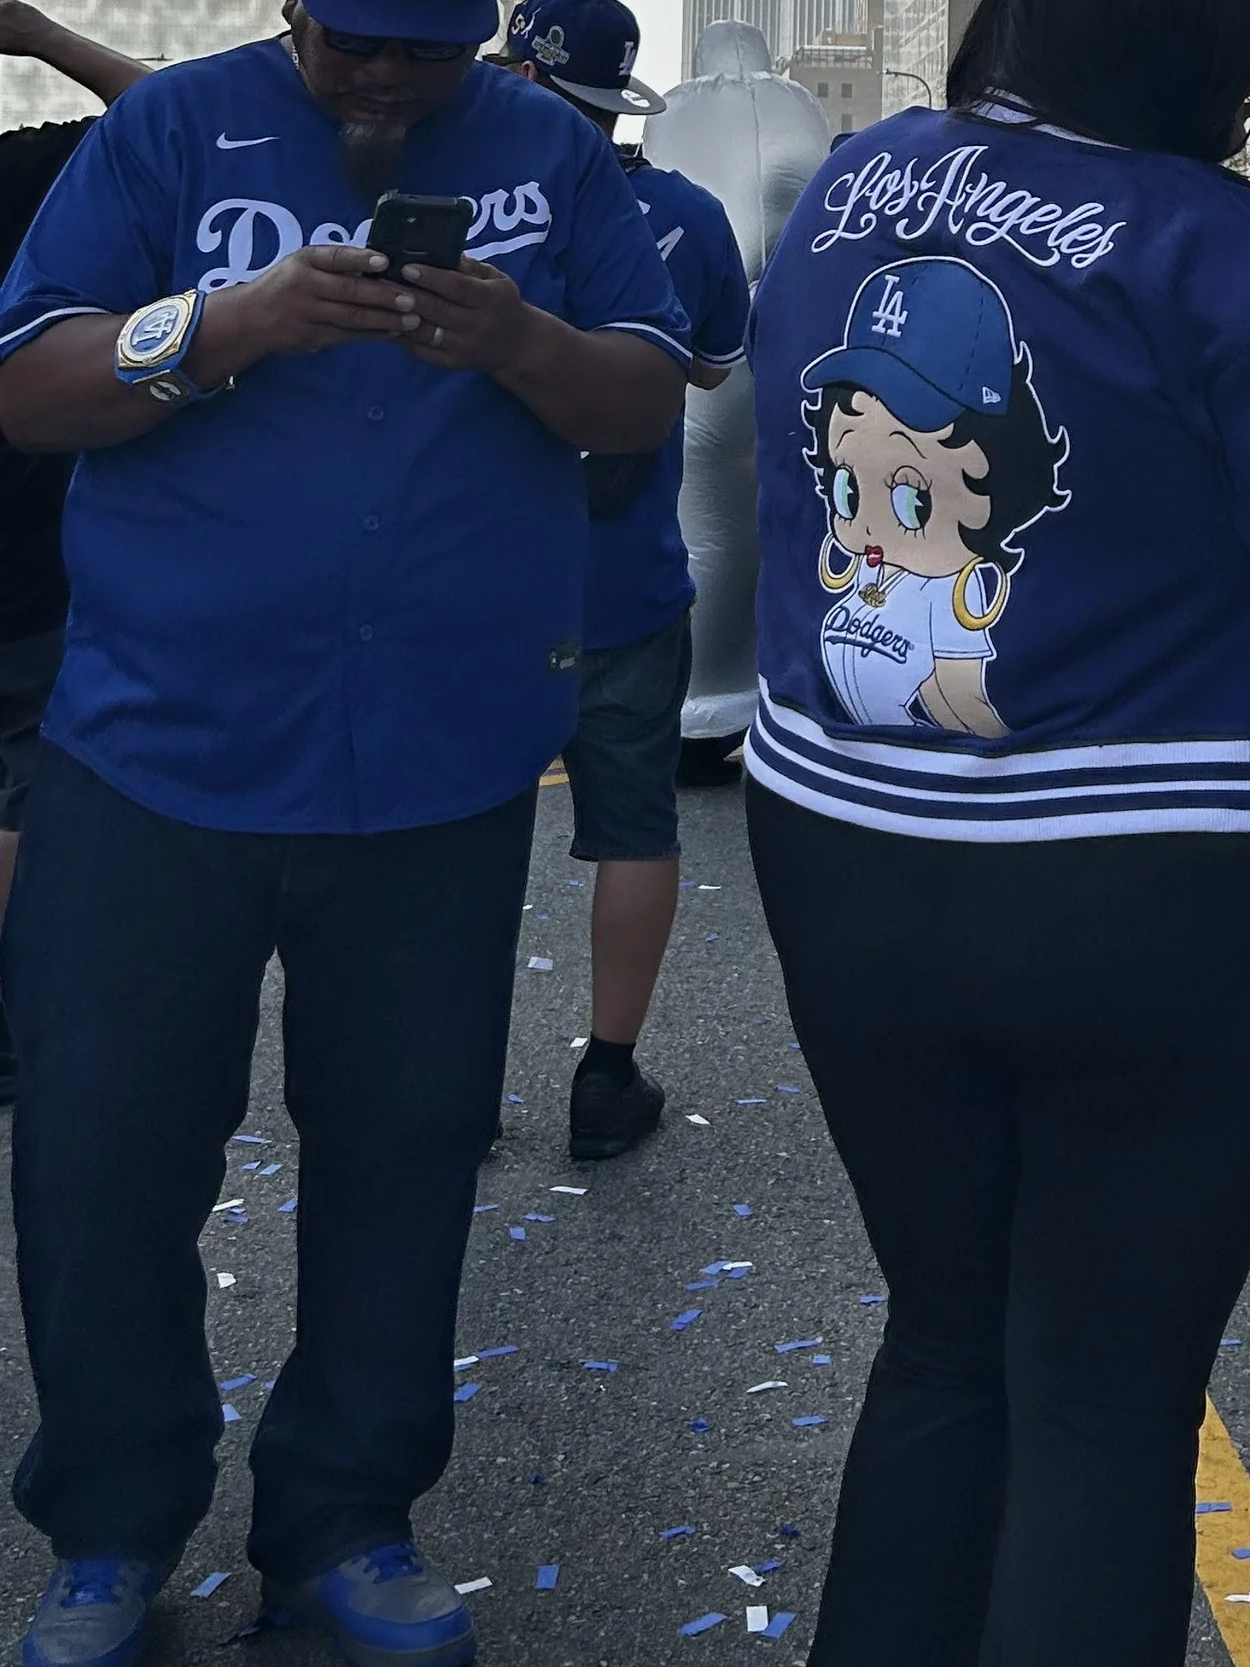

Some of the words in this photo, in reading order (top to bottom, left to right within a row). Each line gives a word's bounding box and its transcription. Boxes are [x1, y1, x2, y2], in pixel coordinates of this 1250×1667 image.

[196, 181, 552, 292] Dors
[811, 151, 919, 253] Los
[896, 145, 1127, 269] Angeles
[871, 274, 909, 338] LA
[824, 605, 911, 664] Dodgers
